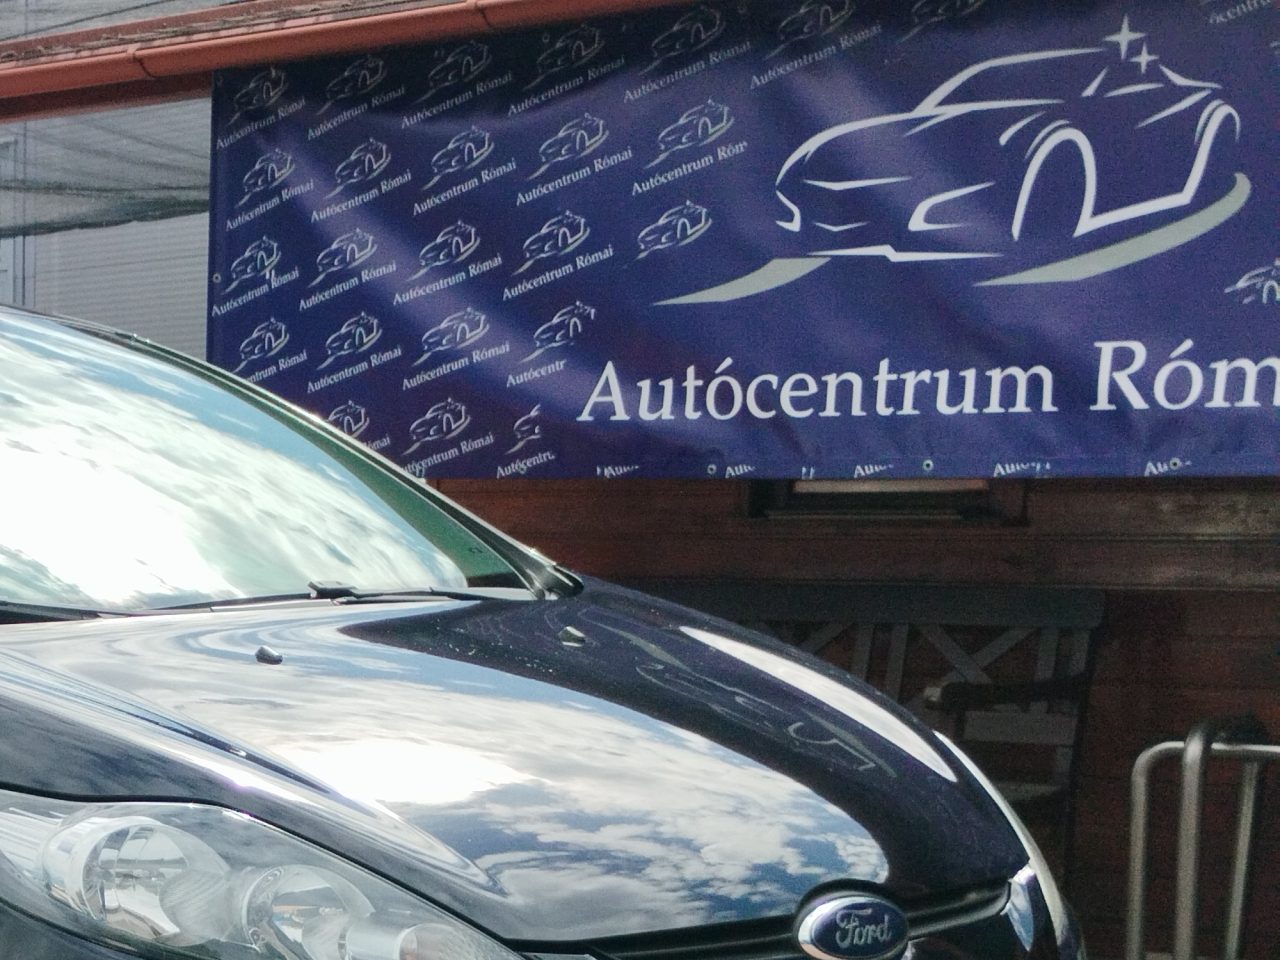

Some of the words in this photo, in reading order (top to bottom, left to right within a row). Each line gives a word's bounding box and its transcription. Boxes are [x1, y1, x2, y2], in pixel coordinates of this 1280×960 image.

[401, 90, 473, 129] Autócentrum
[475, 71, 513, 96] Római
[507, 76, 584, 117] Autócentrum
[623, 58, 706, 103] Autócentrum
[311, 187, 380, 223] Autócentrum
[380, 168, 412, 195] Római
[413, 177, 479, 216] Autócentrum
[481, 157, 517, 183] Római
[516, 165, 591, 206] Autócentrum
[594, 146, 633, 172] Római
[631, 153, 714, 196] Autócentrum
[226, 196, 280, 232] Autócentrum
[299, 275, 359, 312] Autócentrum
[361, 260, 397, 282] Római
[393, 269, 466, 306] Autócentrum
[468, 253, 503, 276] Római
[502, 260, 573, 301] Autócentrum
[575, 243, 614, 269] Római
[211, 282, 269, 317] Autócentrum
[307, 357, 368, 394] Autócentrum
[370, 344, 402, 368] Római
[402, 354, 469, 390] Autócentrum
[472, 341, 510, 363] Római
[576, 356, 1059, 422] Autócentrum
[1089, 337, 1280, 411] Róm
[460, 432, 495, 455] Római
[835, 907, 893, 949] Ford
